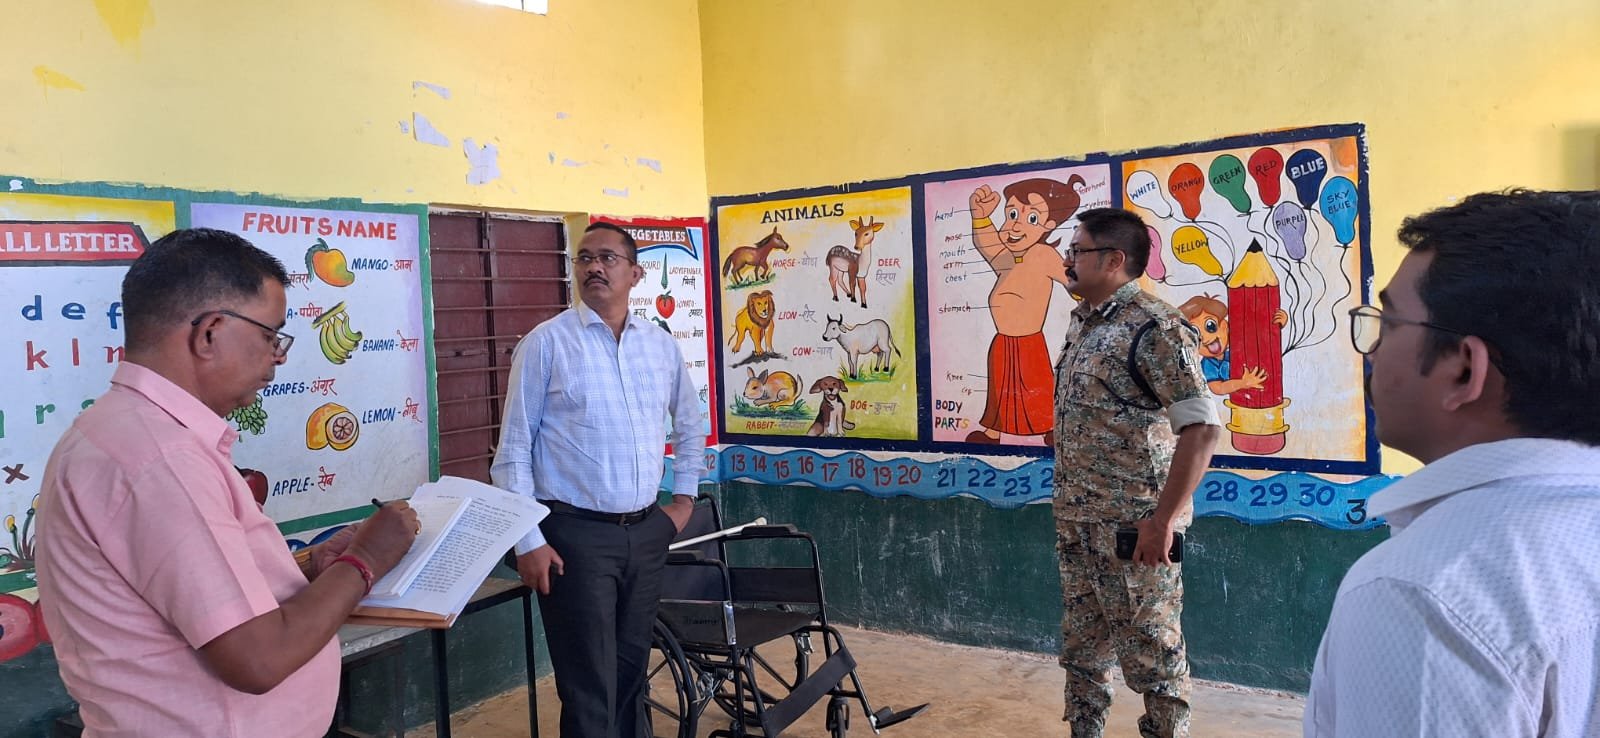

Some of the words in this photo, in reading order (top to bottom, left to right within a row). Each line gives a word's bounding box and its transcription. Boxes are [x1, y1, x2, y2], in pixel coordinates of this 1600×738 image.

[1213, 166, 1242, 186] GREEN
[1255, 160, 1277, 178] RED
[1290, 157, 1325, 180] BLUE
[1130, 181, 1157, 200] WHITE
[1327, 189, 1350, 204] SKY
[760, 202, 845, 224] ANIMALS
[1328, 200, 1351, 215] BLUE
[242, 212, 333, 236] FRUITS
[336, 219, 397, 241] NAME
[1276, 213, 1305, 230] PURPLE
[0, 231, 41, 252] LL
[45, 232, 138, 252] LETTER
[1174, 237, 1209, 255] YELLOW
[878, 257, 901, 270] DEER
[22, 295, 42, 321] d
[61, 302, 86, 320] e
[26, 340, 49, 370] k
[35, 402, 55, 424] r
[935, 399, 963, 413] BODY
[935, 418, 970, 431] PARTS
[705, 453, 716, 470] 12
[731, 454, 746, 472] 13
[752, 455, 767, 473] 14
[773, 460, 790, 480] 15
[797, 455, 814, 474] 16
[821, 462, 840, 482] 17
[847, 458, 866, 479] 18
[873, 466, 892, 487] 19
[898, 464, 921, 485] 20
[937, 468, 956, 488] 21
[967, 468, 997, 488] 22
[1004, 476, 1032, 497] 23
[1041, 467, 1053, 488] 2
[1205, 480, 1239, 502] 28
[1250, 482, 1288, 507] 29
[1299, 483, 1336, 507] 30
[1346, 498, 1376, 525] 3
